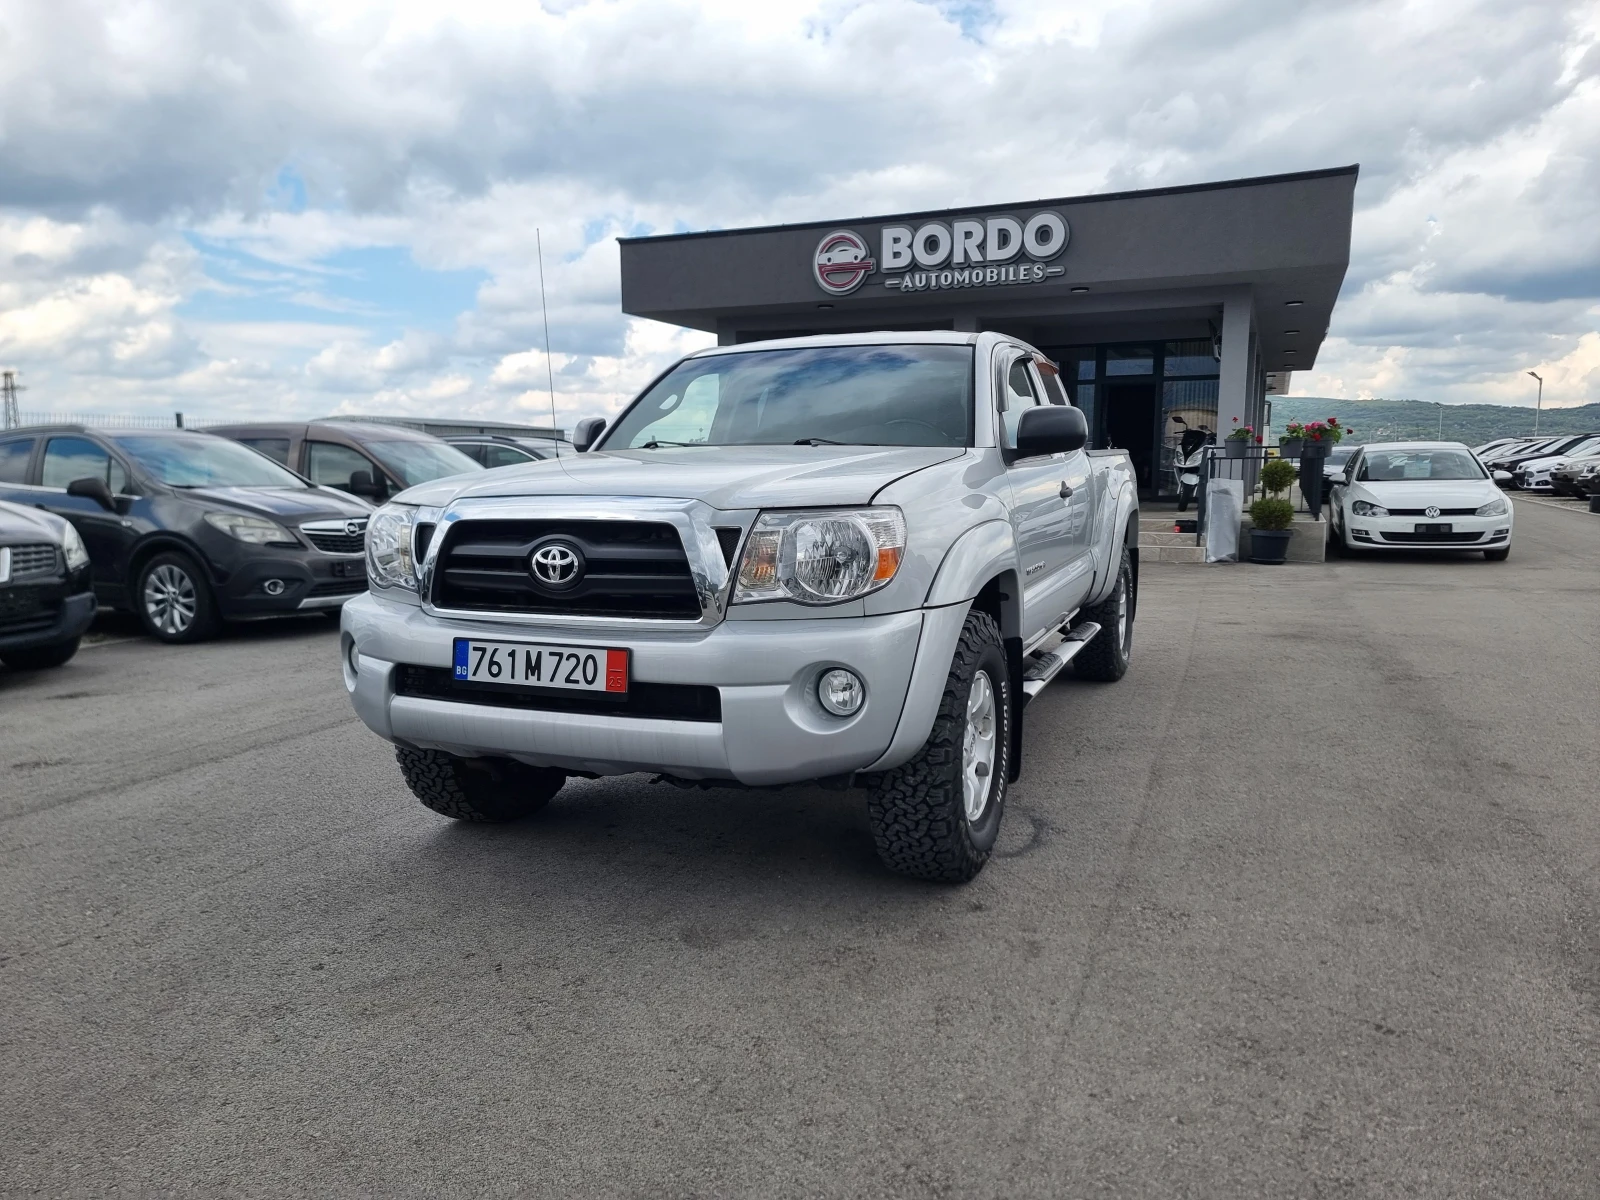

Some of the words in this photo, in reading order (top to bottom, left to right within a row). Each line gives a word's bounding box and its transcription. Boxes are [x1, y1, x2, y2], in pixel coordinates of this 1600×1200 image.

[882, 213, 1066, 269] BORDO
[902, 265, 1044, 289] AUTOMOBILES
[456, 665, 467, 675] BG
[608, 676, 623, 687] 25
